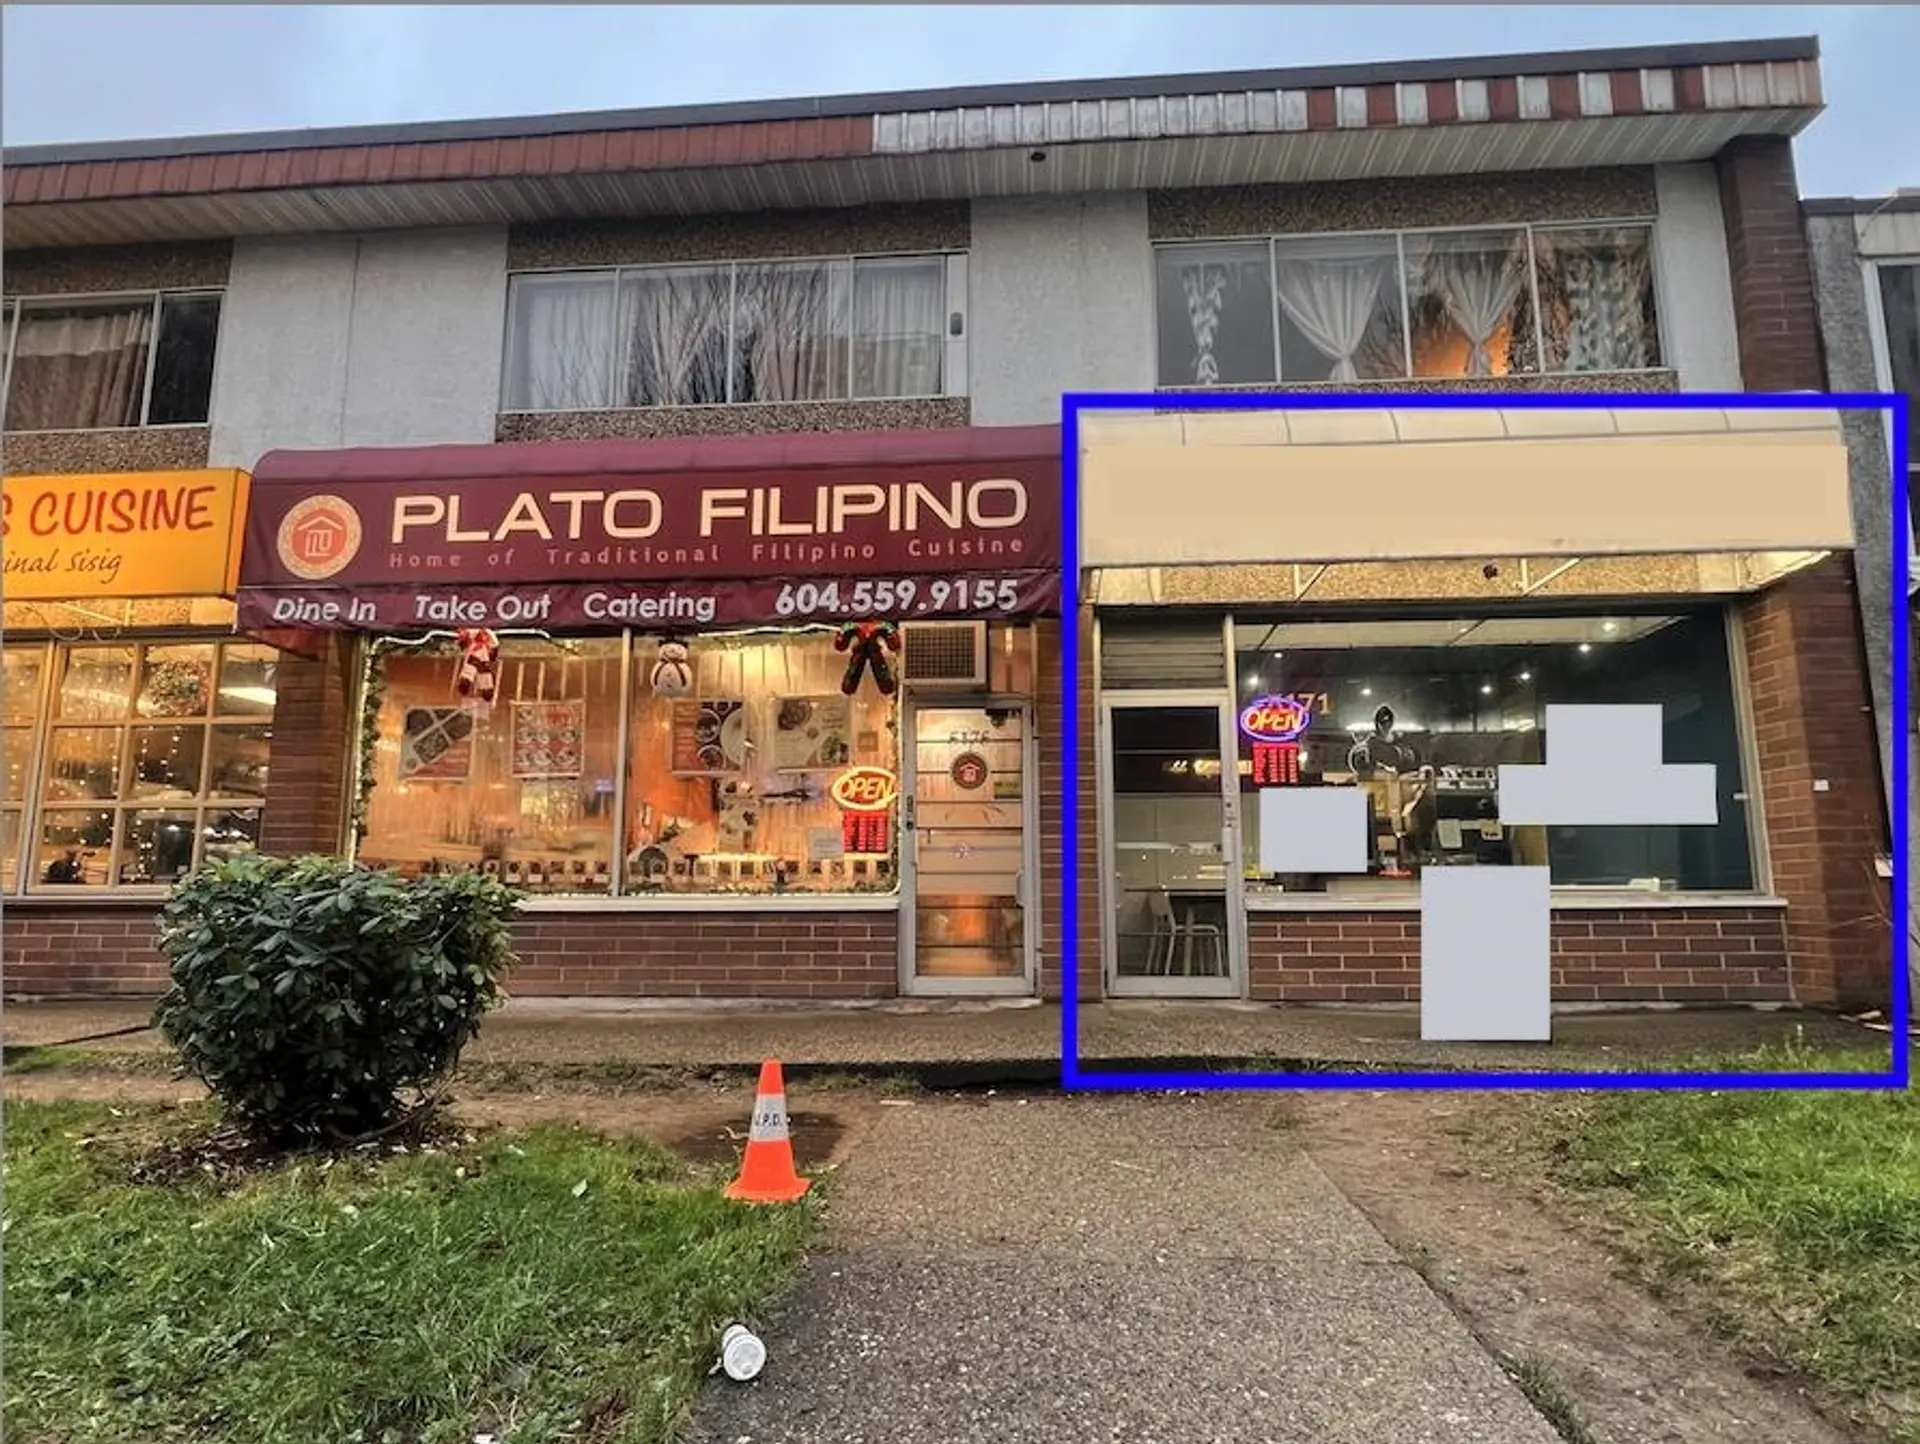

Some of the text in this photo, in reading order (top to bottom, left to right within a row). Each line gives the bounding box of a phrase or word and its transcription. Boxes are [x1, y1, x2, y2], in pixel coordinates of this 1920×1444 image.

[30, 485, 217, 536] CUISINE
[391, 478, 1028, 544] PLATO FILIPINO
[390, 537, 1023, 568] Home of Traditional Filipino Cuisine
[273, 579, 1018, 623] Dine In Take Out Catering 604.559.9155
[1246, 708, 1303, 732] OPEN
[840, 776, 893, 800] OPEN
